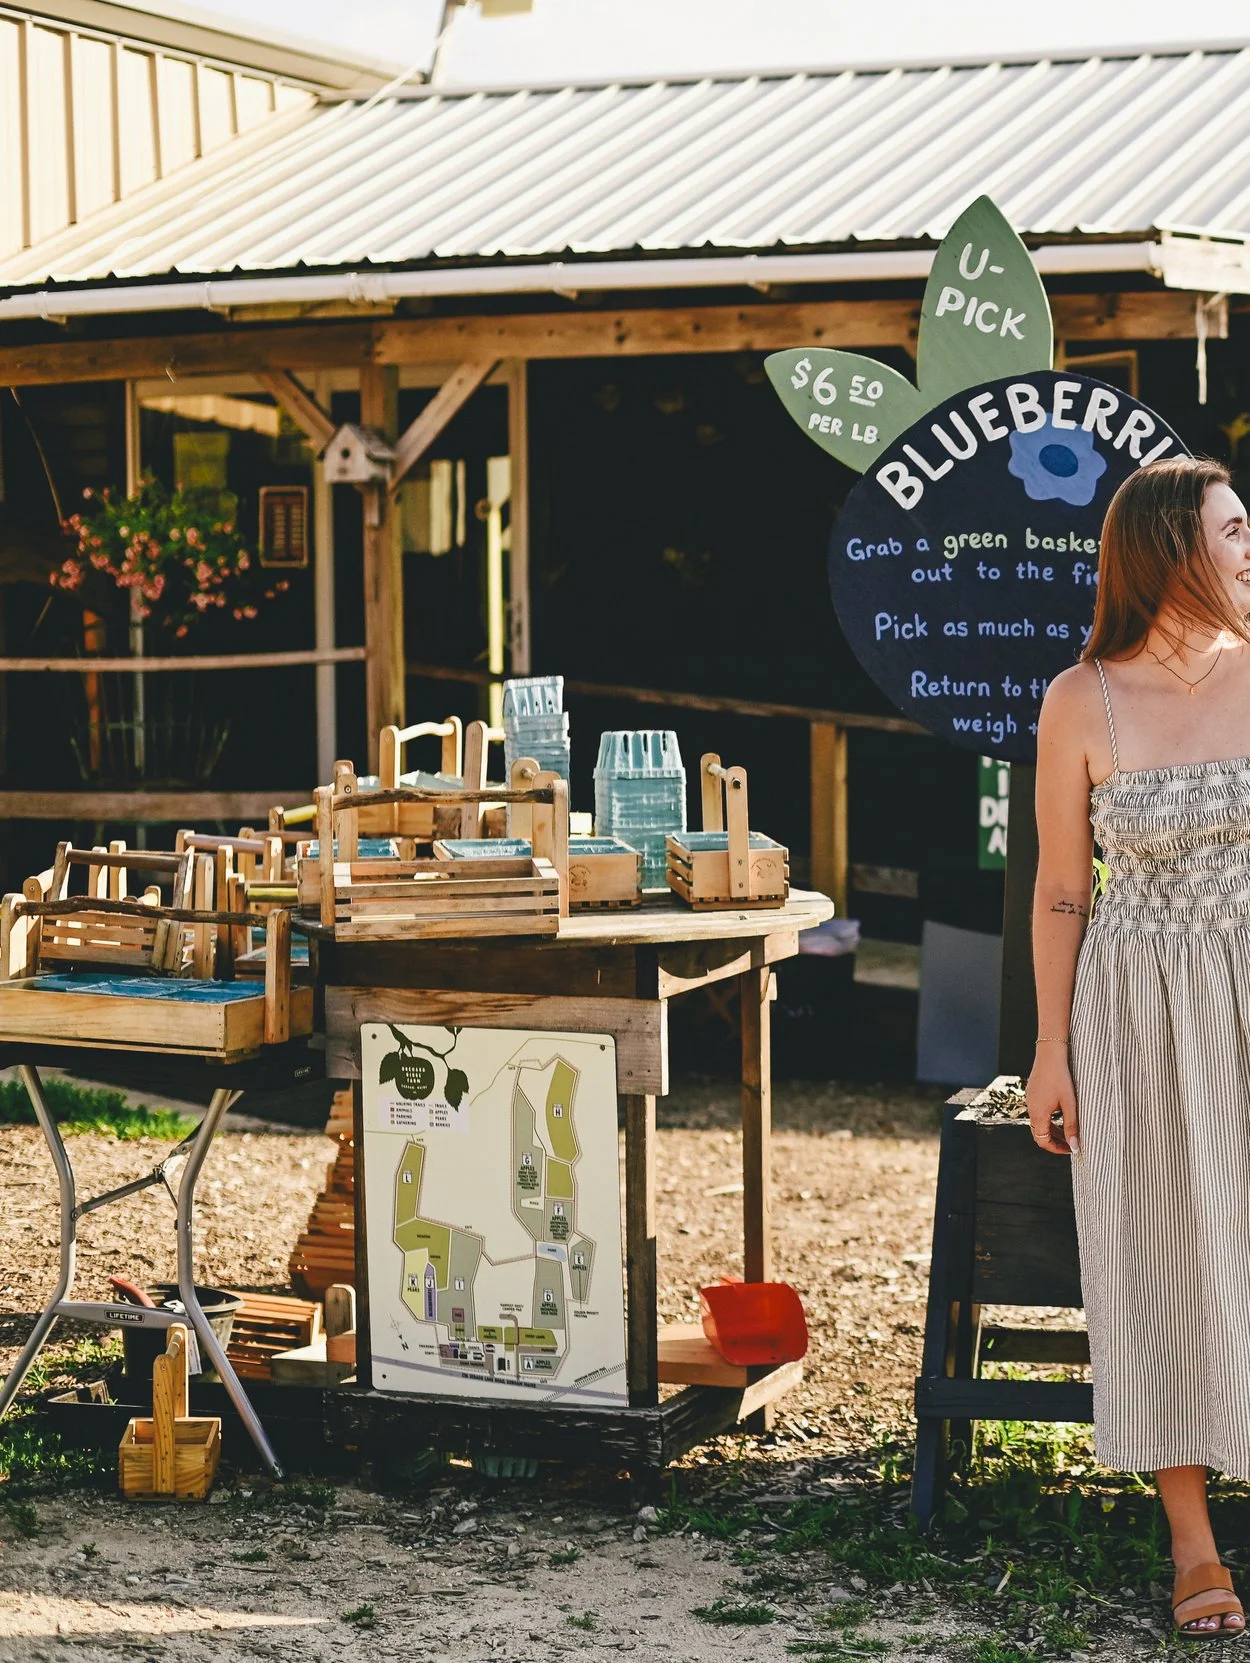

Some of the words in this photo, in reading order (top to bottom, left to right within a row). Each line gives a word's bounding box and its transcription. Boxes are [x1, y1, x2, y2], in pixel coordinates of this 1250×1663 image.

[958, 243, 1005, 281] U-
[935, 286, 1027, 340] PICK
[808, 413, 842, 436] PER
[851, 423, 878, 444] LB
[876, 381, 1196, 510] BLUEBERRI
[847, 538, 902, 560] Grab
[916, 538, 929, 551] a
[944, 532, 1007, 559] green
[1026, 528, 1101, 554] baske
[912, 563, 952, 582] out
[977, 561, 1000, 580] to
[1016, 561, 1054, 582] the
[875, 612, 928, 640] Pick
[944, 621, 968, 636] as
[978, 618, 1034, 637] much
[1046, 623, 1069, 638] as
[911, 670, 990, 698] Return
[1001, 675, 1021, 696] to
[1030, 678, 1048, 699] th
[953, 712, 1016, 743] weigh
[525, 1156, 529, 1164] G
[411, 1278, 416, 1286] K
[428, 1279, 431, 1287] J
[110, 1312, 140, 1320] LIFETIME
